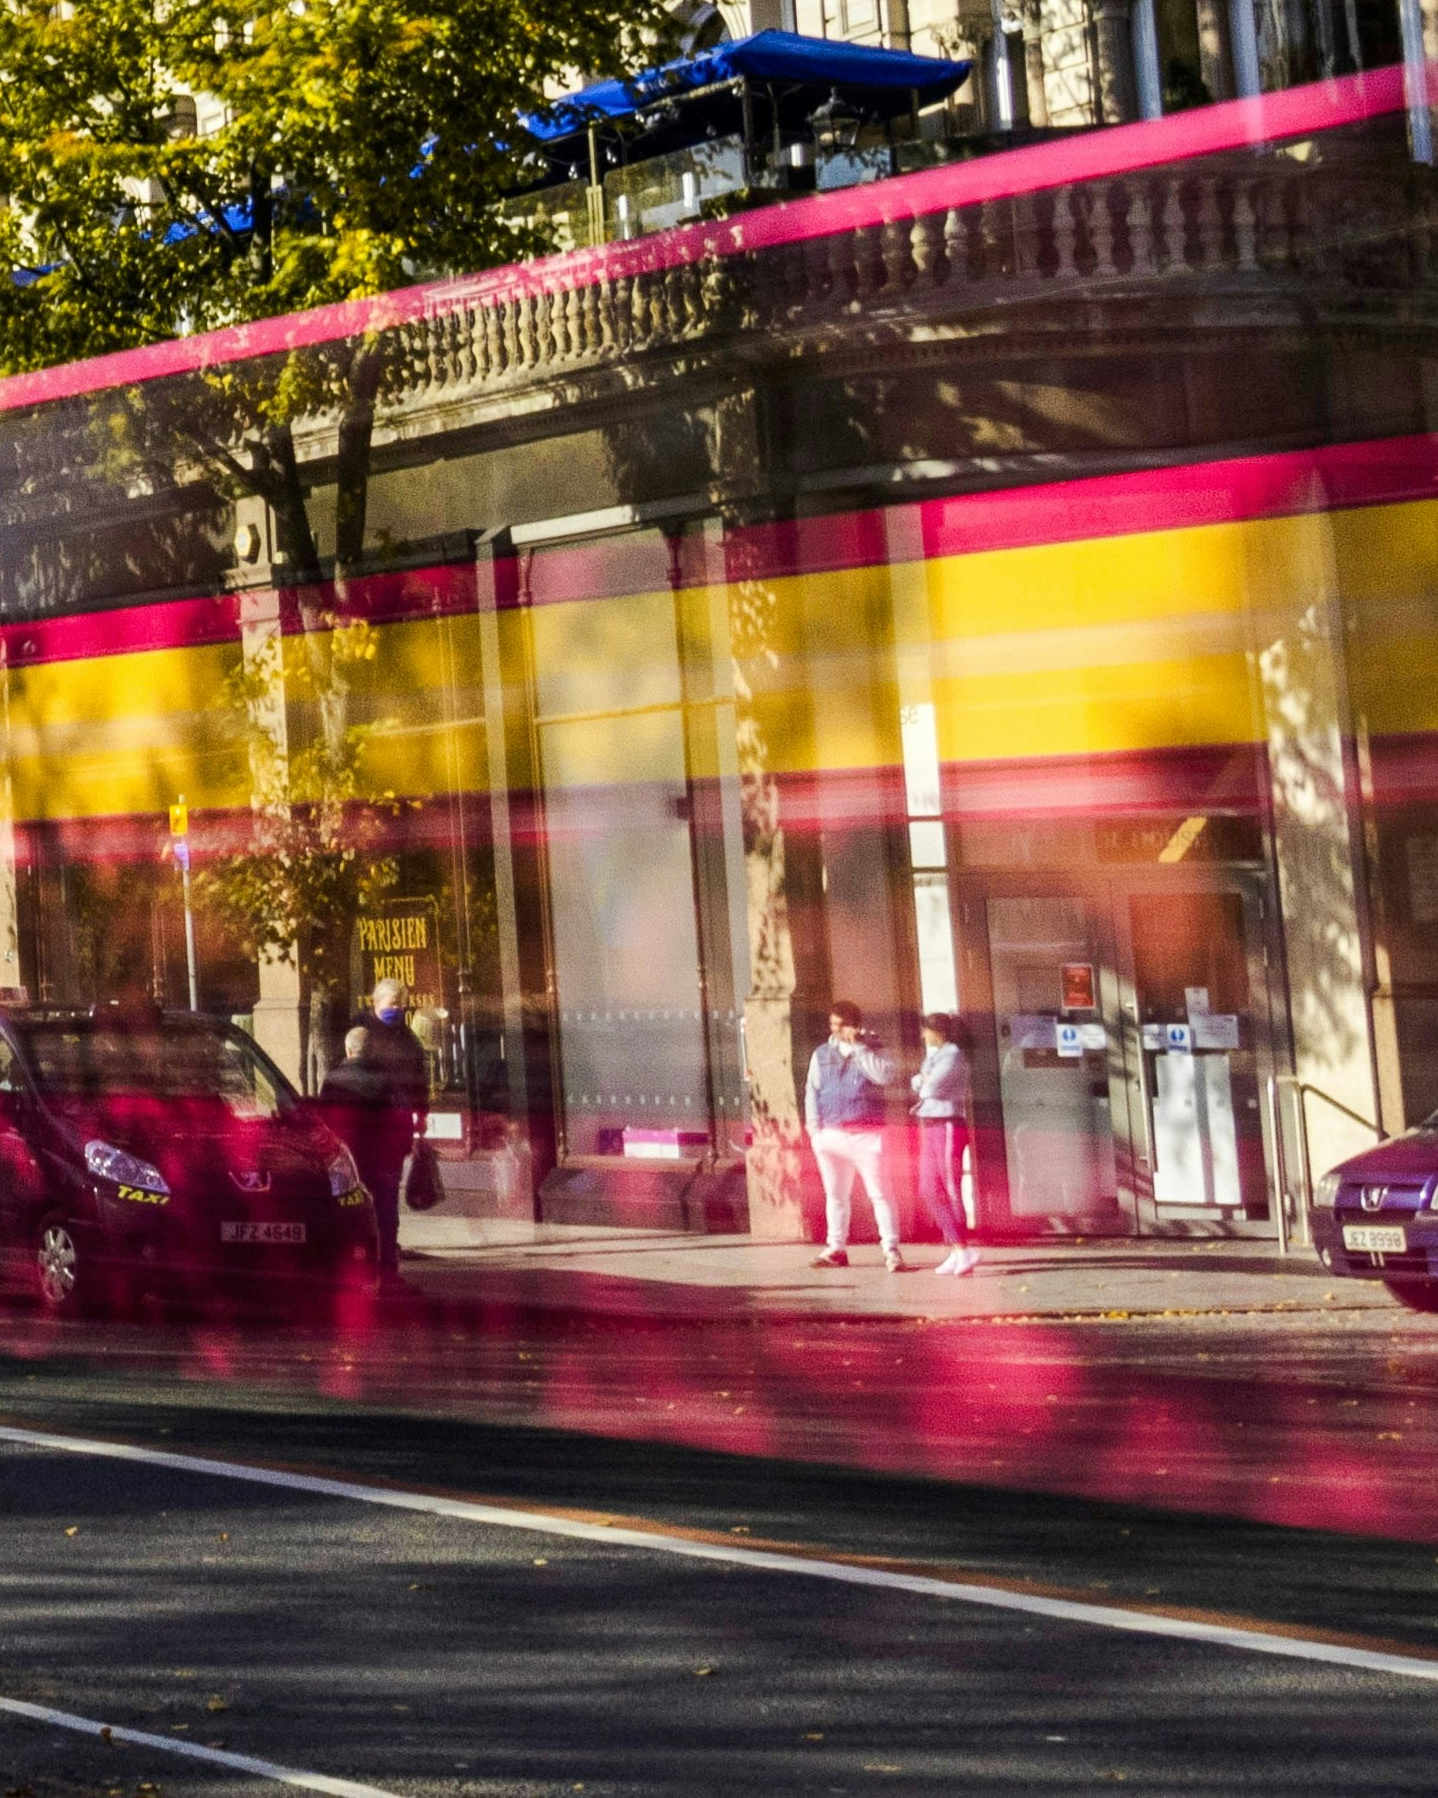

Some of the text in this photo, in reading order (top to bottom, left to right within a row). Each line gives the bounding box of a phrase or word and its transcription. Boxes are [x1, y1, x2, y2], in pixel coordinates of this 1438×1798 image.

[357, 917, 428, 952] PARISIEN
[374, 956, 415, 987] MENU
[117, 1185, 172, 1205] TAXI
